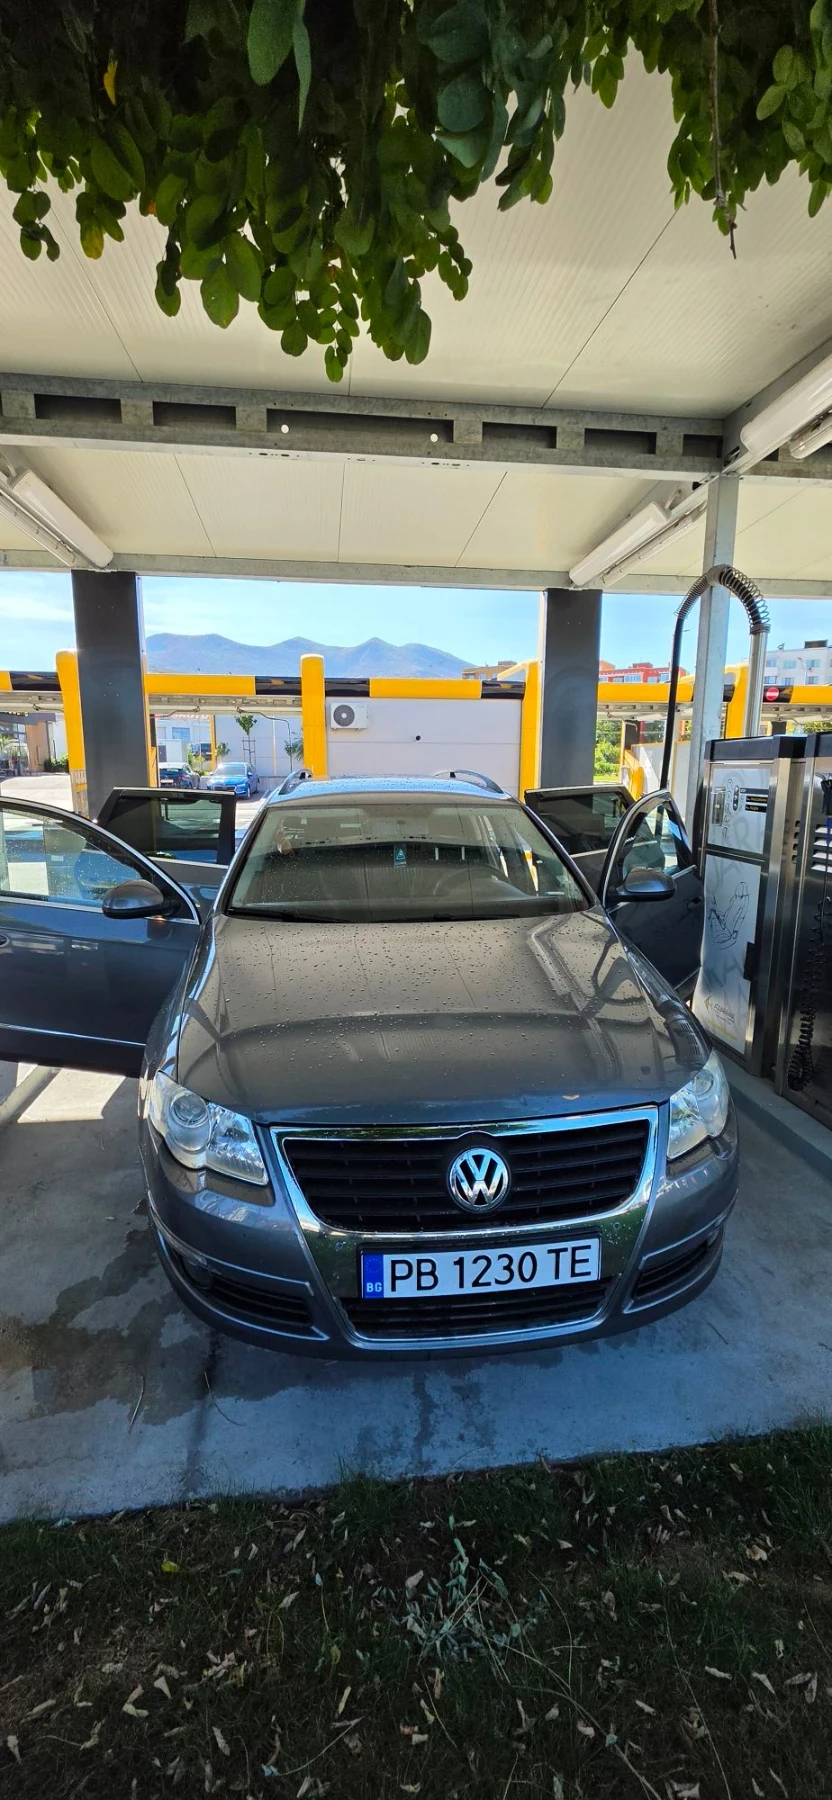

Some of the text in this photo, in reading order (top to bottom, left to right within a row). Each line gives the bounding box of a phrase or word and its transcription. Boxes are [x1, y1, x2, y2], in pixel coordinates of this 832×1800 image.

[450, 1149, 509, 1208] VW
[366, 1282, 382, 1293] BG
[390, 1244, 592, 1292] PB 1230 TE
